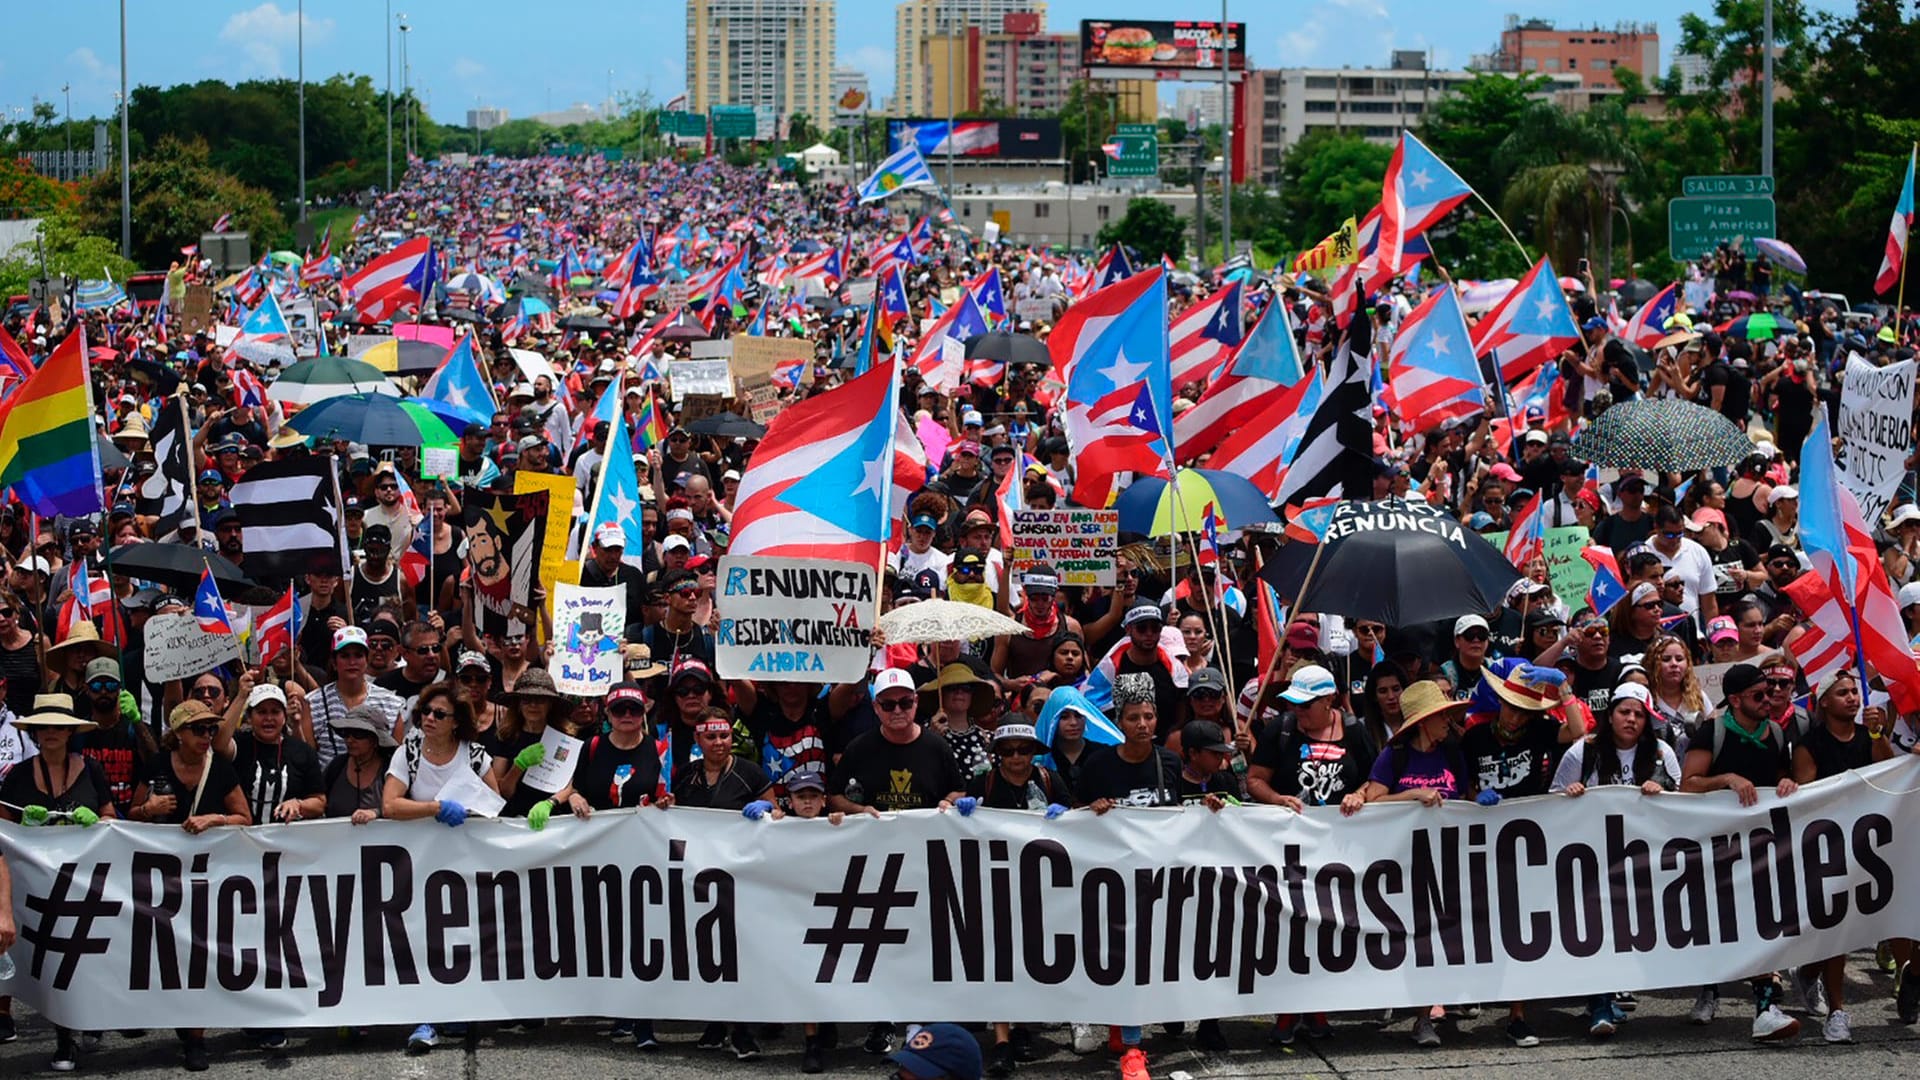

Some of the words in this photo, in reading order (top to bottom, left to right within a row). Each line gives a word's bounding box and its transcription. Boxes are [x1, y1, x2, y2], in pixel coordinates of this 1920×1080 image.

[1687, 181, 1737, 193] SALIDA
[1703, 204, 1741, 215] Plaza
[1674, 221, 1699, 231] Las
[1708, 220, 1769, 230] Americas
[1012, 523, 1062, 534] CANSADA
[1066, 525, 1079, 534] DE
[1081, 523, 1101, 534] SER
[1323, 513, 1468, 549] RENUNCIA
[724, 566, 873, 602] RENUNCIA
[832, 602, 860, 628] YA
[748, 651, 825, 672] AHORA
[561, 664, 585, 681] Bad
[587, 667, 612, 684] Boy
[20, 839, 739, 1008] #RickyRenuncia
[803, 806, 1894, 994] #NiCorruptosNiCobardes
